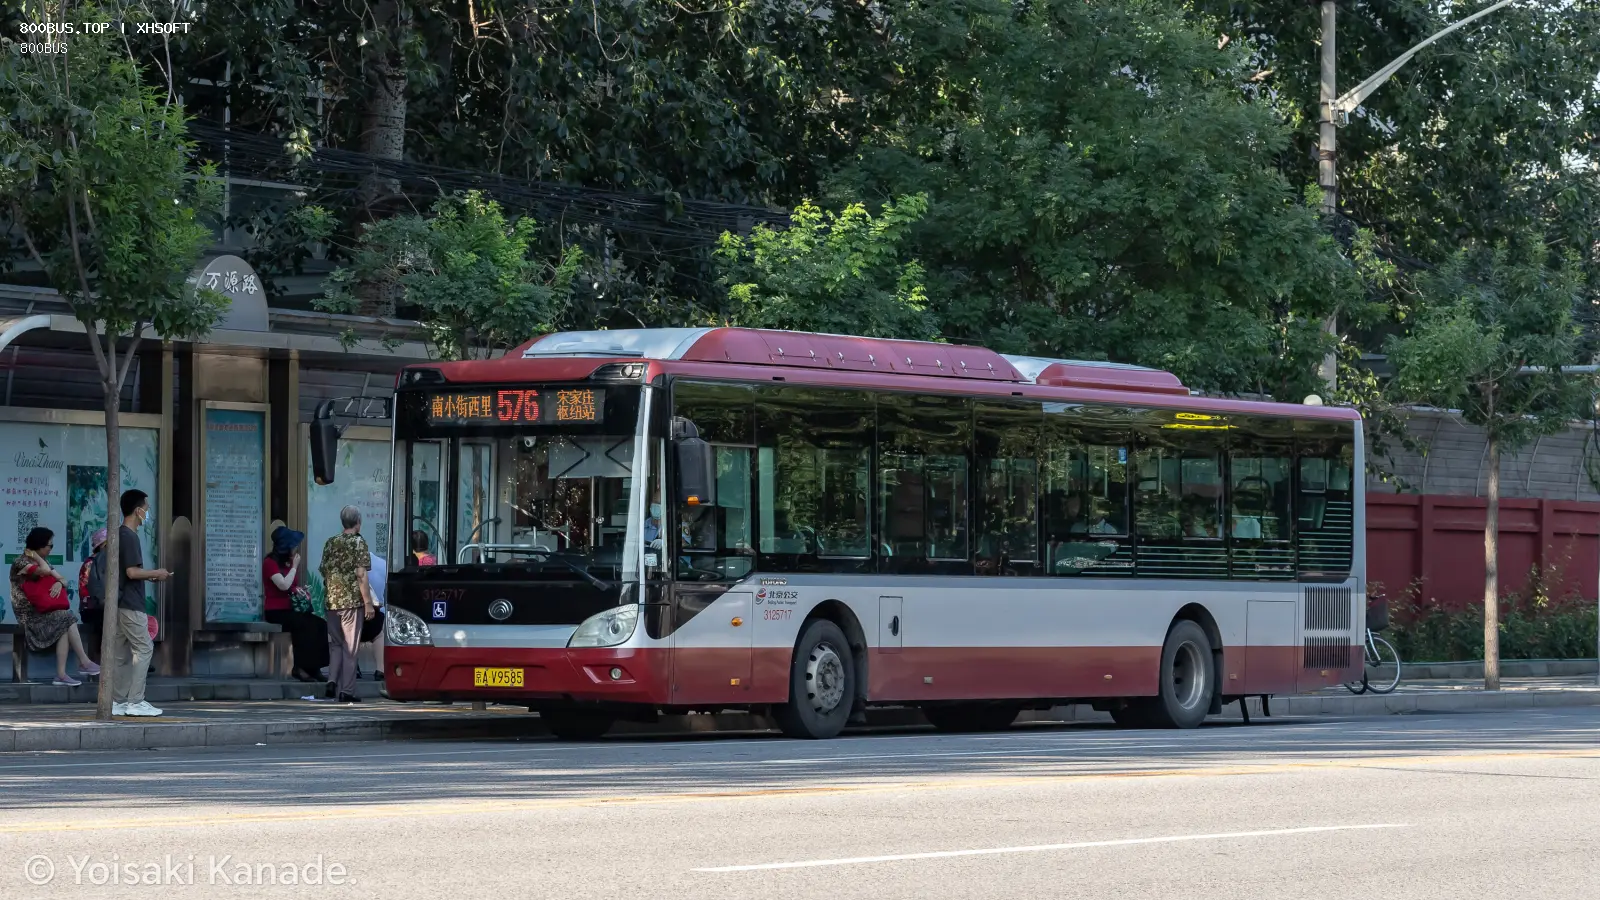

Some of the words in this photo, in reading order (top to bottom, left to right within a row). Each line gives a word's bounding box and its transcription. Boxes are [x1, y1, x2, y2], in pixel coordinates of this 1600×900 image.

[205, 270, 258, 295] 万源路
[497, 389, 539, 421] 576
[556, 389, 595, 405] 宋家庄
[431, 394, 492, 418] 南小街西里
[556, 405, 596, 421] 枢纽站
[424, 588, 465, 600] 3125717
[768, 591, 798, 599] 北京公交
[764, 610, 792, 620] 3125717
